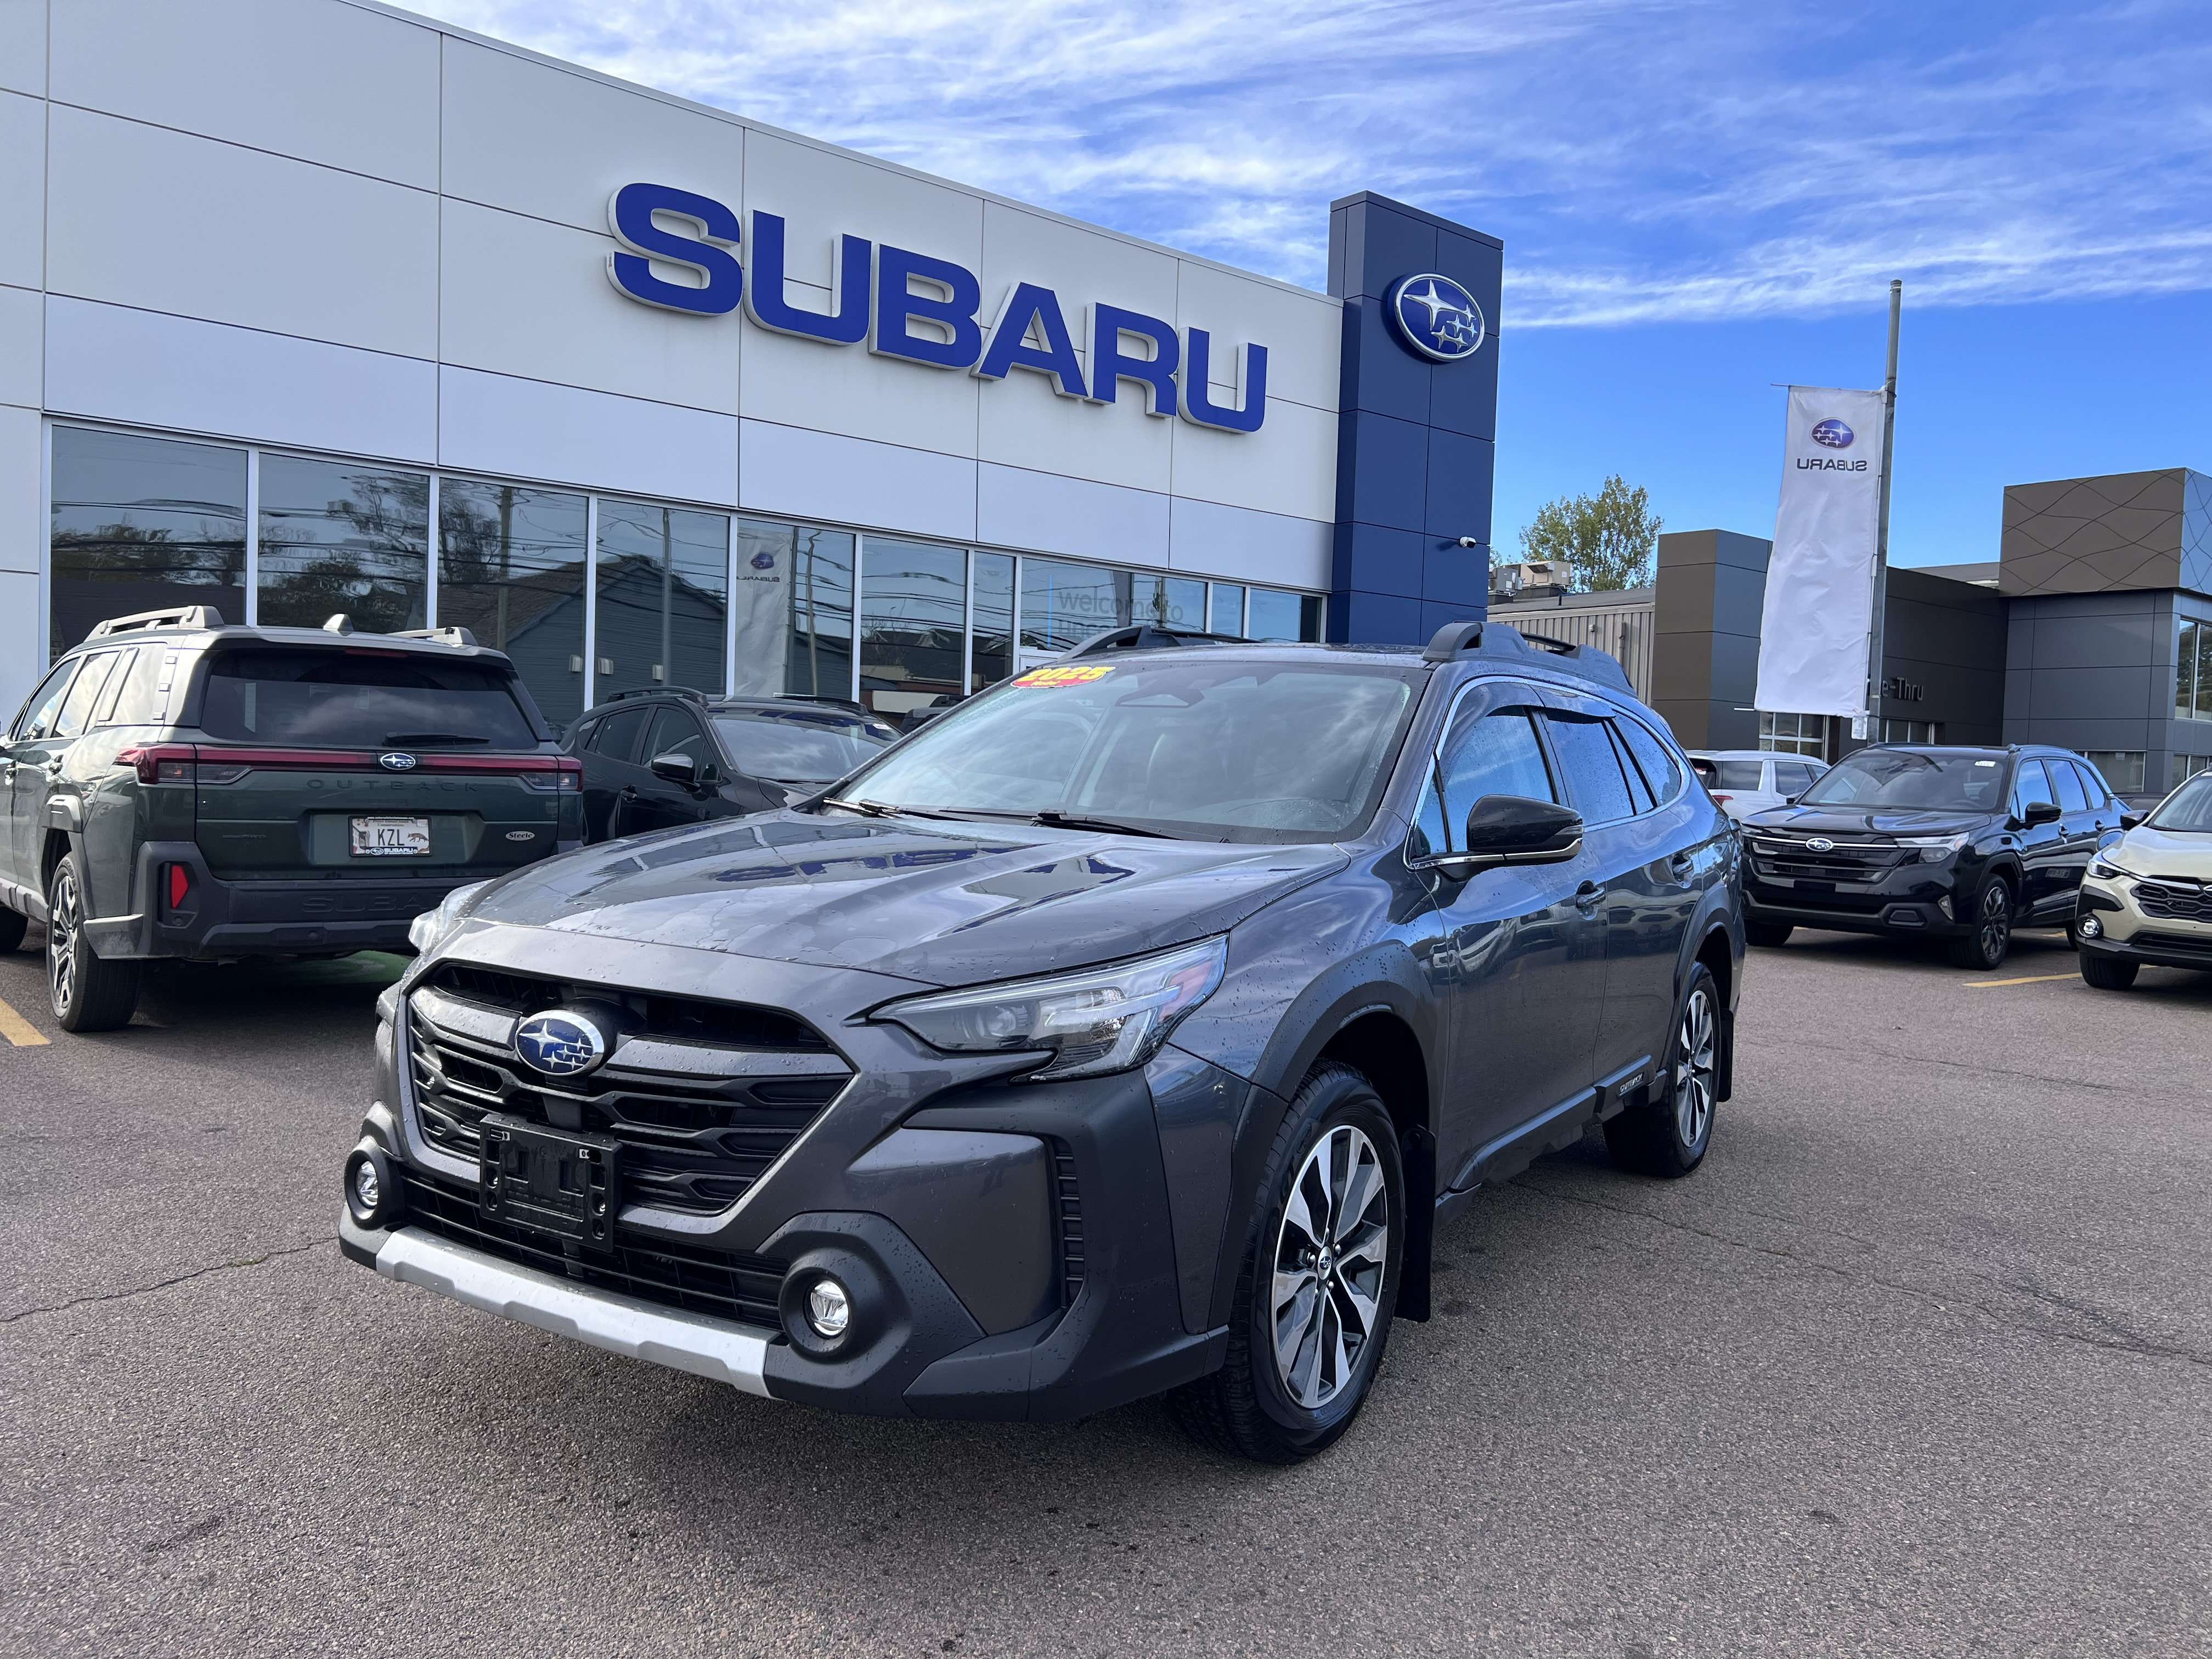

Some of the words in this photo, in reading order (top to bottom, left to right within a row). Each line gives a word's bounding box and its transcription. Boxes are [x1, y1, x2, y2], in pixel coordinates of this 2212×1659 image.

[607, 182, 1268, 435] SUBARU
[1016, 666, 1116, 682] 2025
[1882, 676, 1923, 701] e-Thru
[307, 779, 478, 792] OUTBACK
[377, 828, 405, 846] KZL
[302, 894, 444, 912] SUBA
